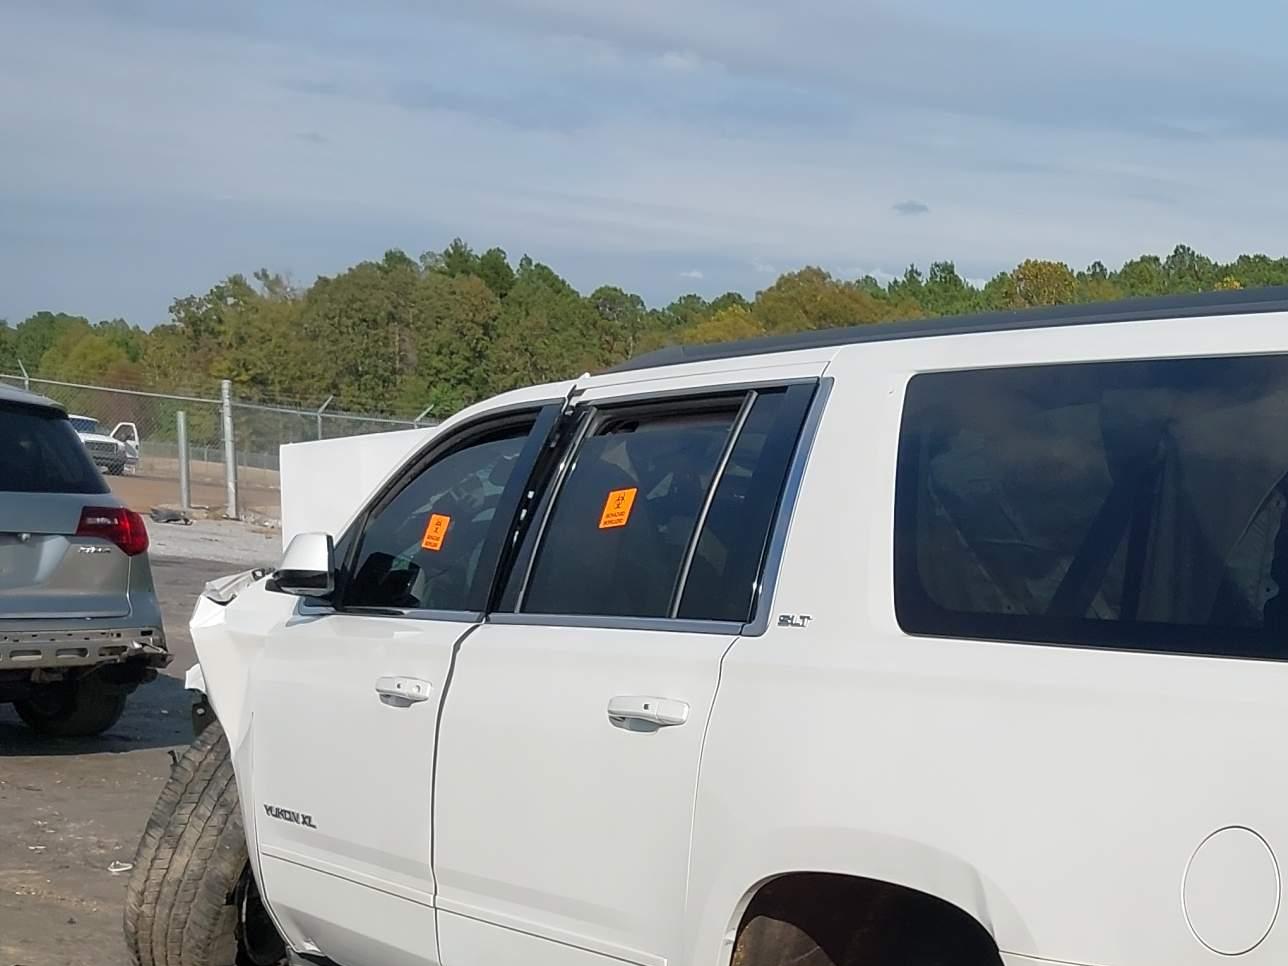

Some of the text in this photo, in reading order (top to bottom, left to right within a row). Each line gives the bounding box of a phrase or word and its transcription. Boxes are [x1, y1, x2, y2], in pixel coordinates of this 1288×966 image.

[778, 614, 812, 628] SLT
[263, 804, 317, 829] YUKON XL
